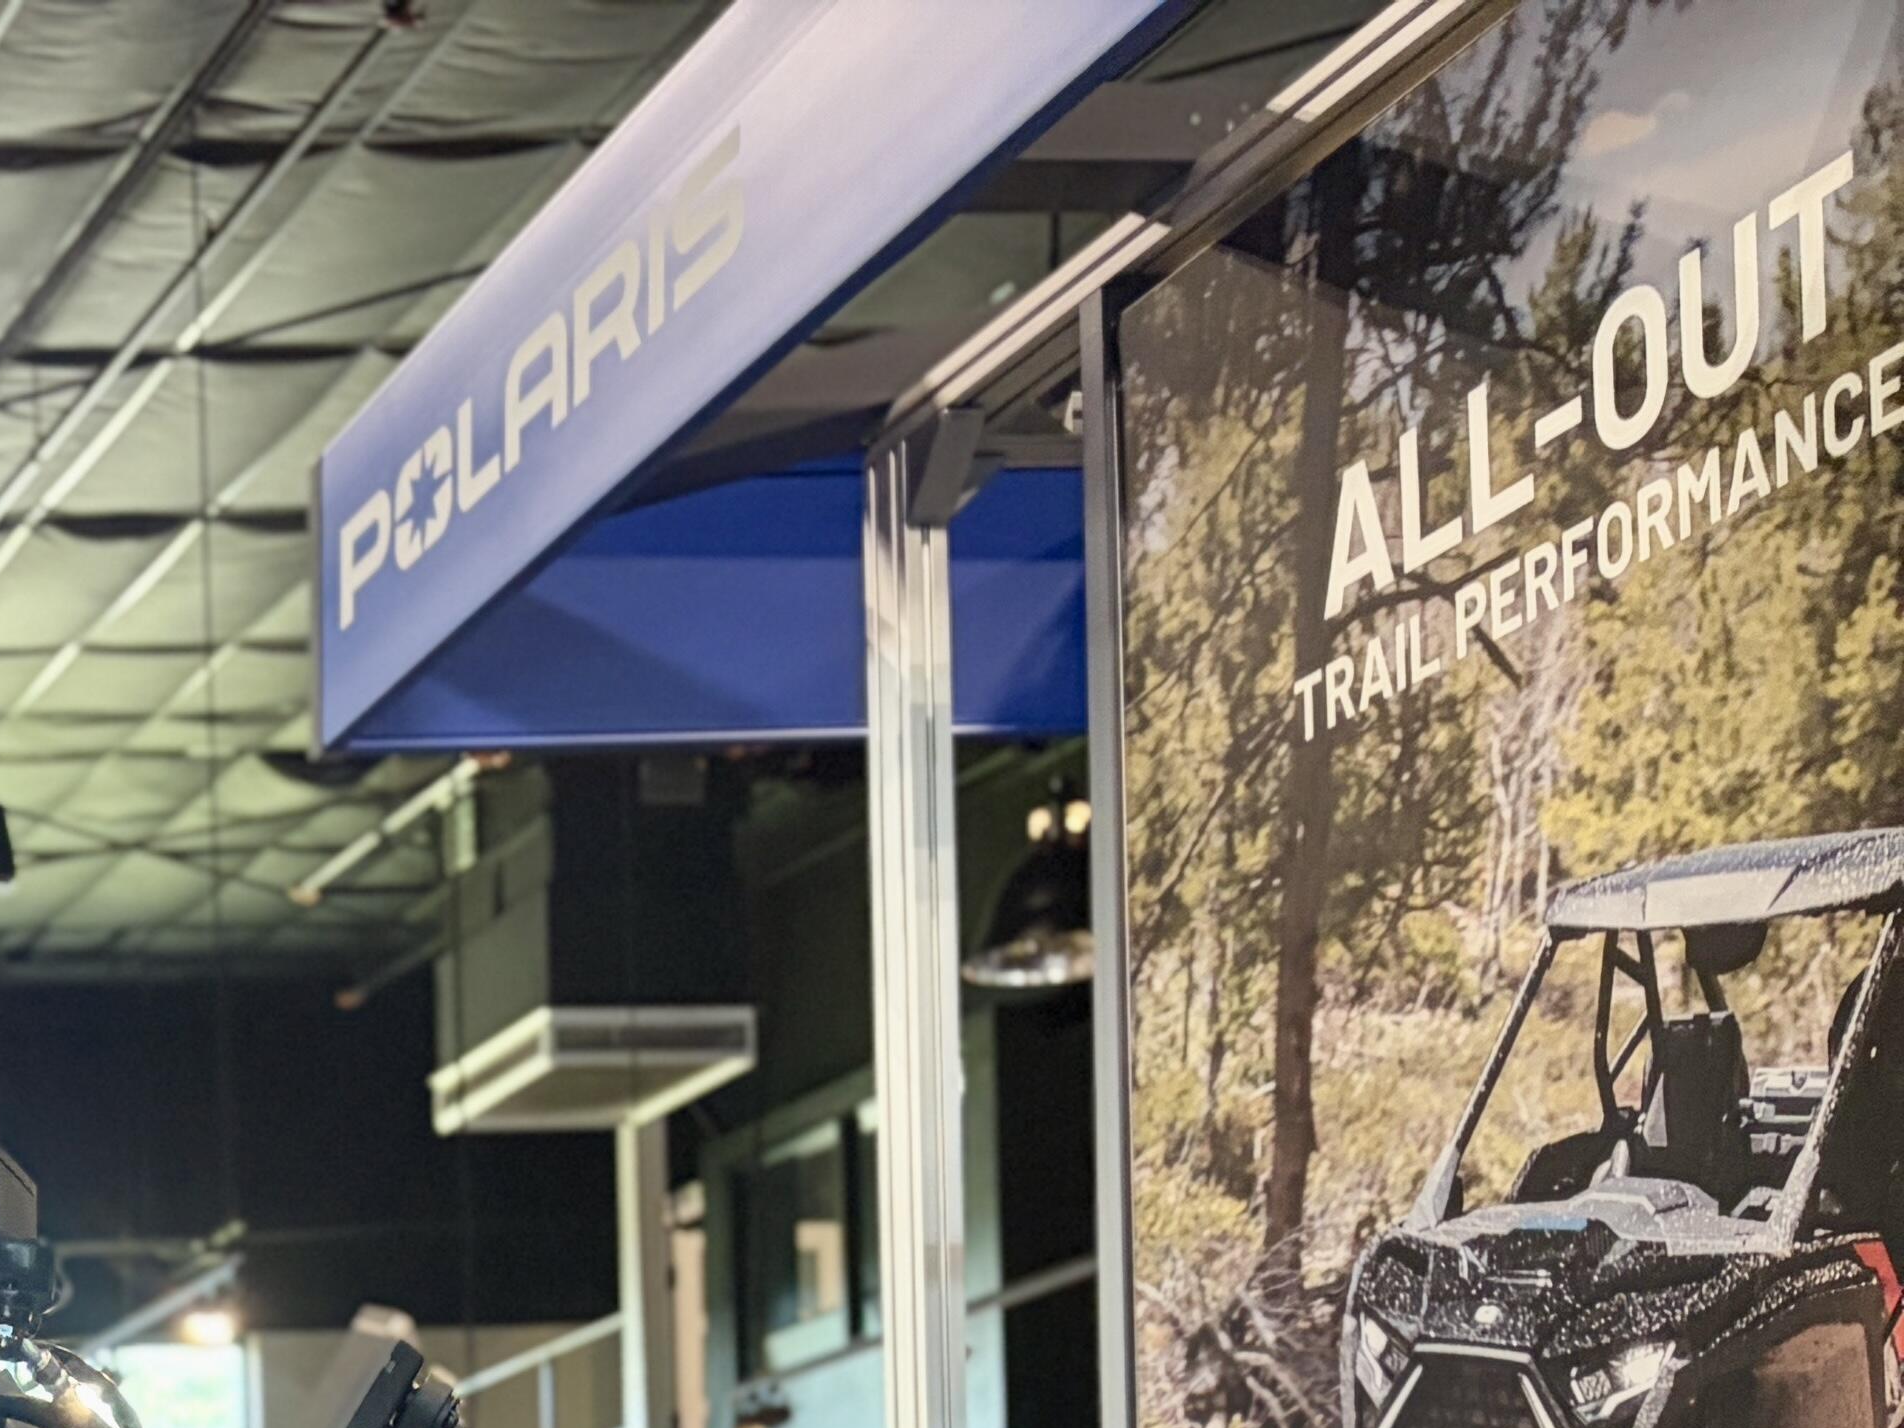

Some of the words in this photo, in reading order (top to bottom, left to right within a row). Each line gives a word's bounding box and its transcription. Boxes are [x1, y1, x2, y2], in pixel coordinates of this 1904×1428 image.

[339, 123, 745, 631] POLARIS
[1293, 604, 1441, 743] TRAIL
[1454, 342, 1904, 660] PERFORMANCE
[1323, 150, 1853, 621] ALL-OUT
